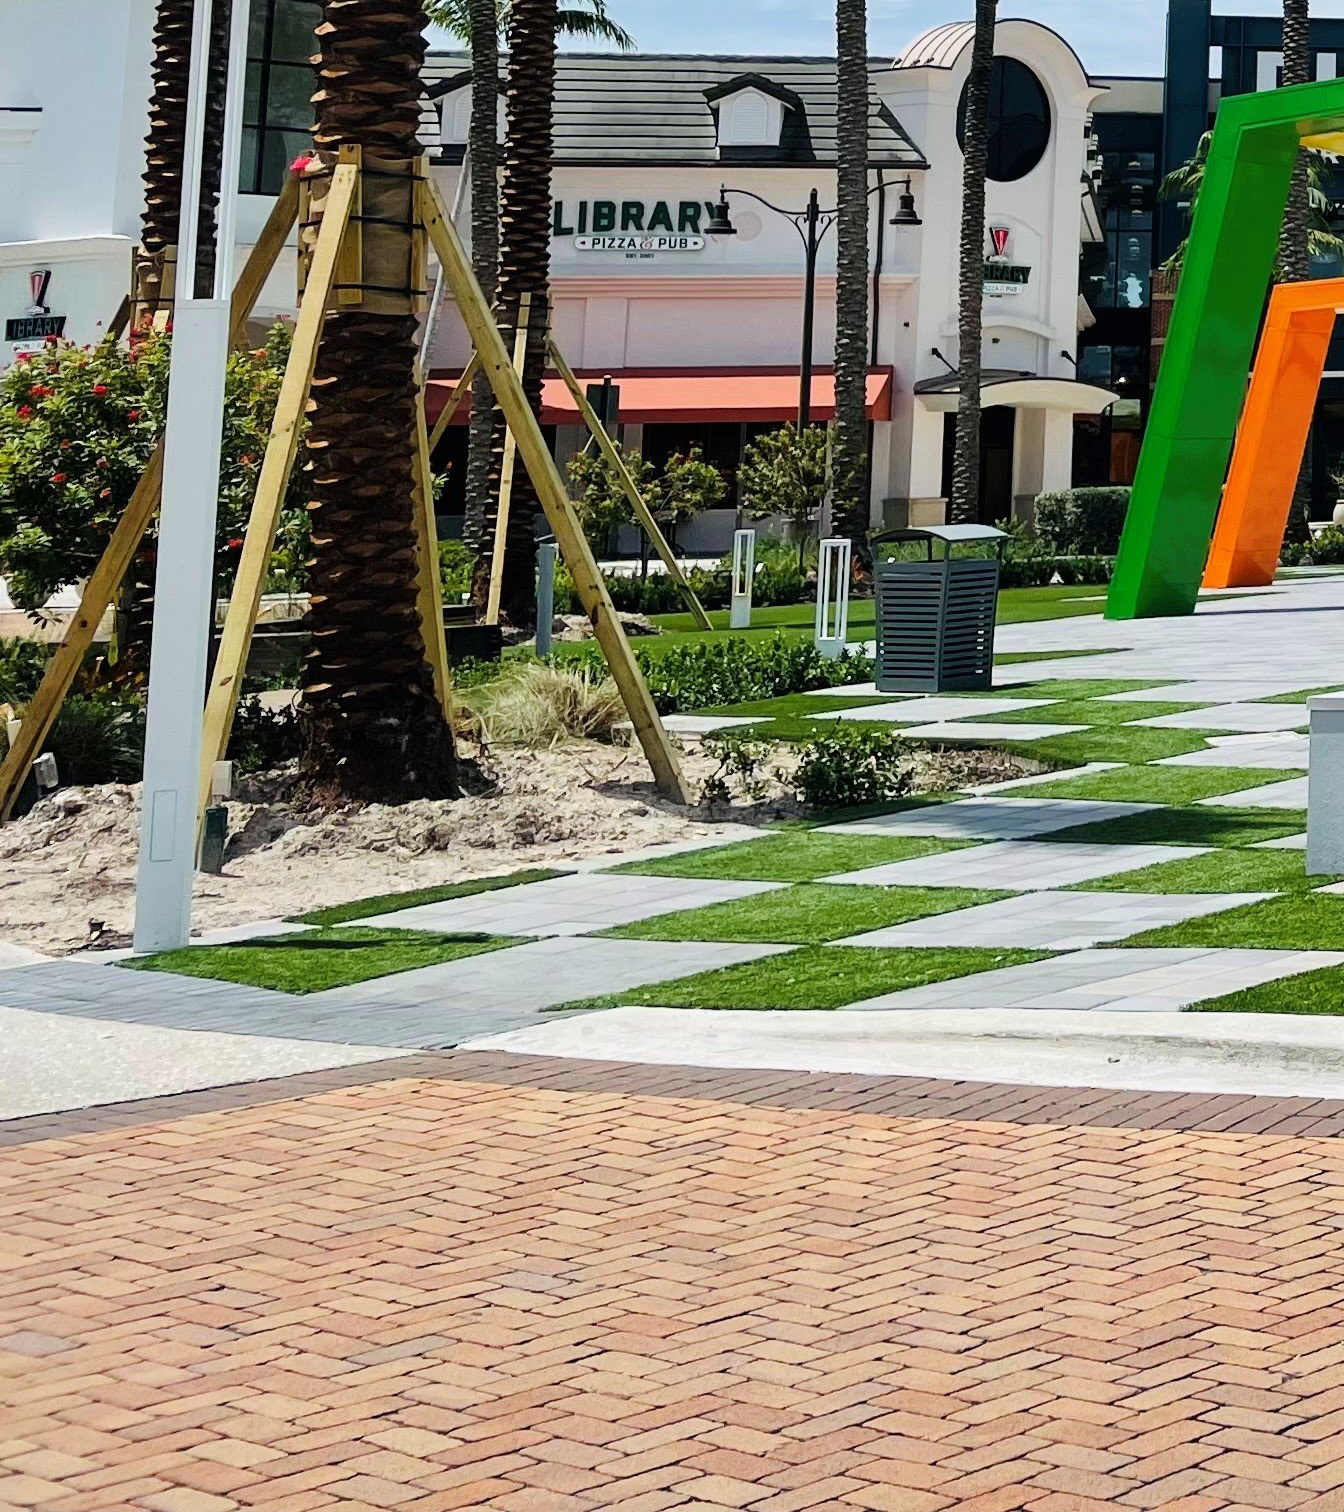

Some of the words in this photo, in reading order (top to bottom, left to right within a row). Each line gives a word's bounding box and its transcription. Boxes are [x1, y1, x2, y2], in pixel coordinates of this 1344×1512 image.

[592, 238, 636, 249] PIZZA
[658, 238, 688, 248] PUB
[981, 264, 1031, 283] BRARY
